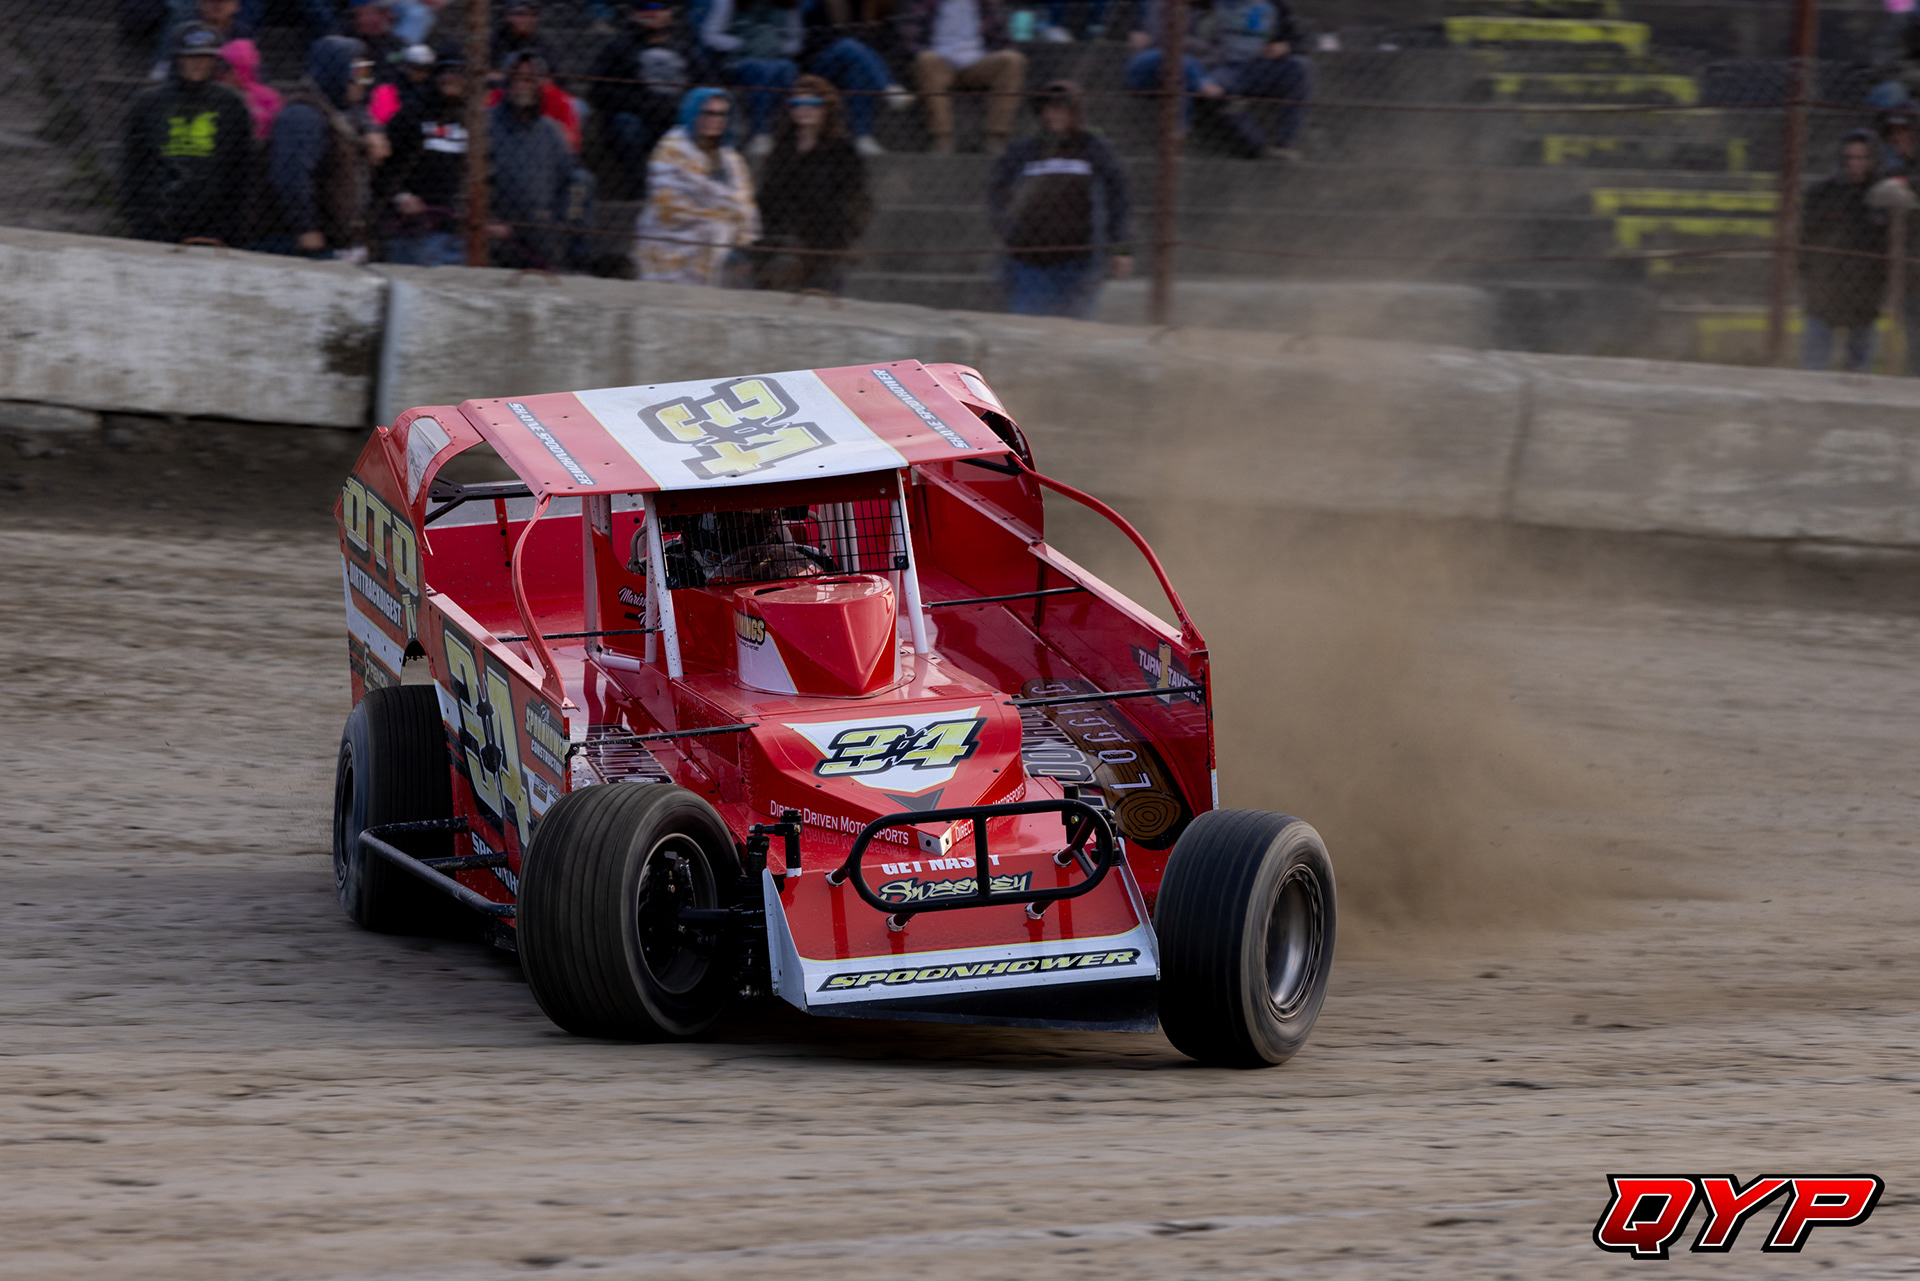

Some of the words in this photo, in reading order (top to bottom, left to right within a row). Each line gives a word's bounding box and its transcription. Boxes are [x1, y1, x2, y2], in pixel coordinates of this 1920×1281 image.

[508, 402, 546, 432] SHAYNE
[535, 431, 594, 486] SPOONHOWER
[639, 376, 836, 479] 34
[1138, 648, 1162, 679] TURN
[815, 717, 986, 777] 34
[803, 808, 839, 830] DRIVEN
[840, 816, 909, 845] MOTOSPORTS
[954, 819, 974, 842] DIRECT
[881, 861, 922, 876] GET
[928, 855, 999, 872] NASY
[824, 950, 1136, 990] SPOONHOWER
